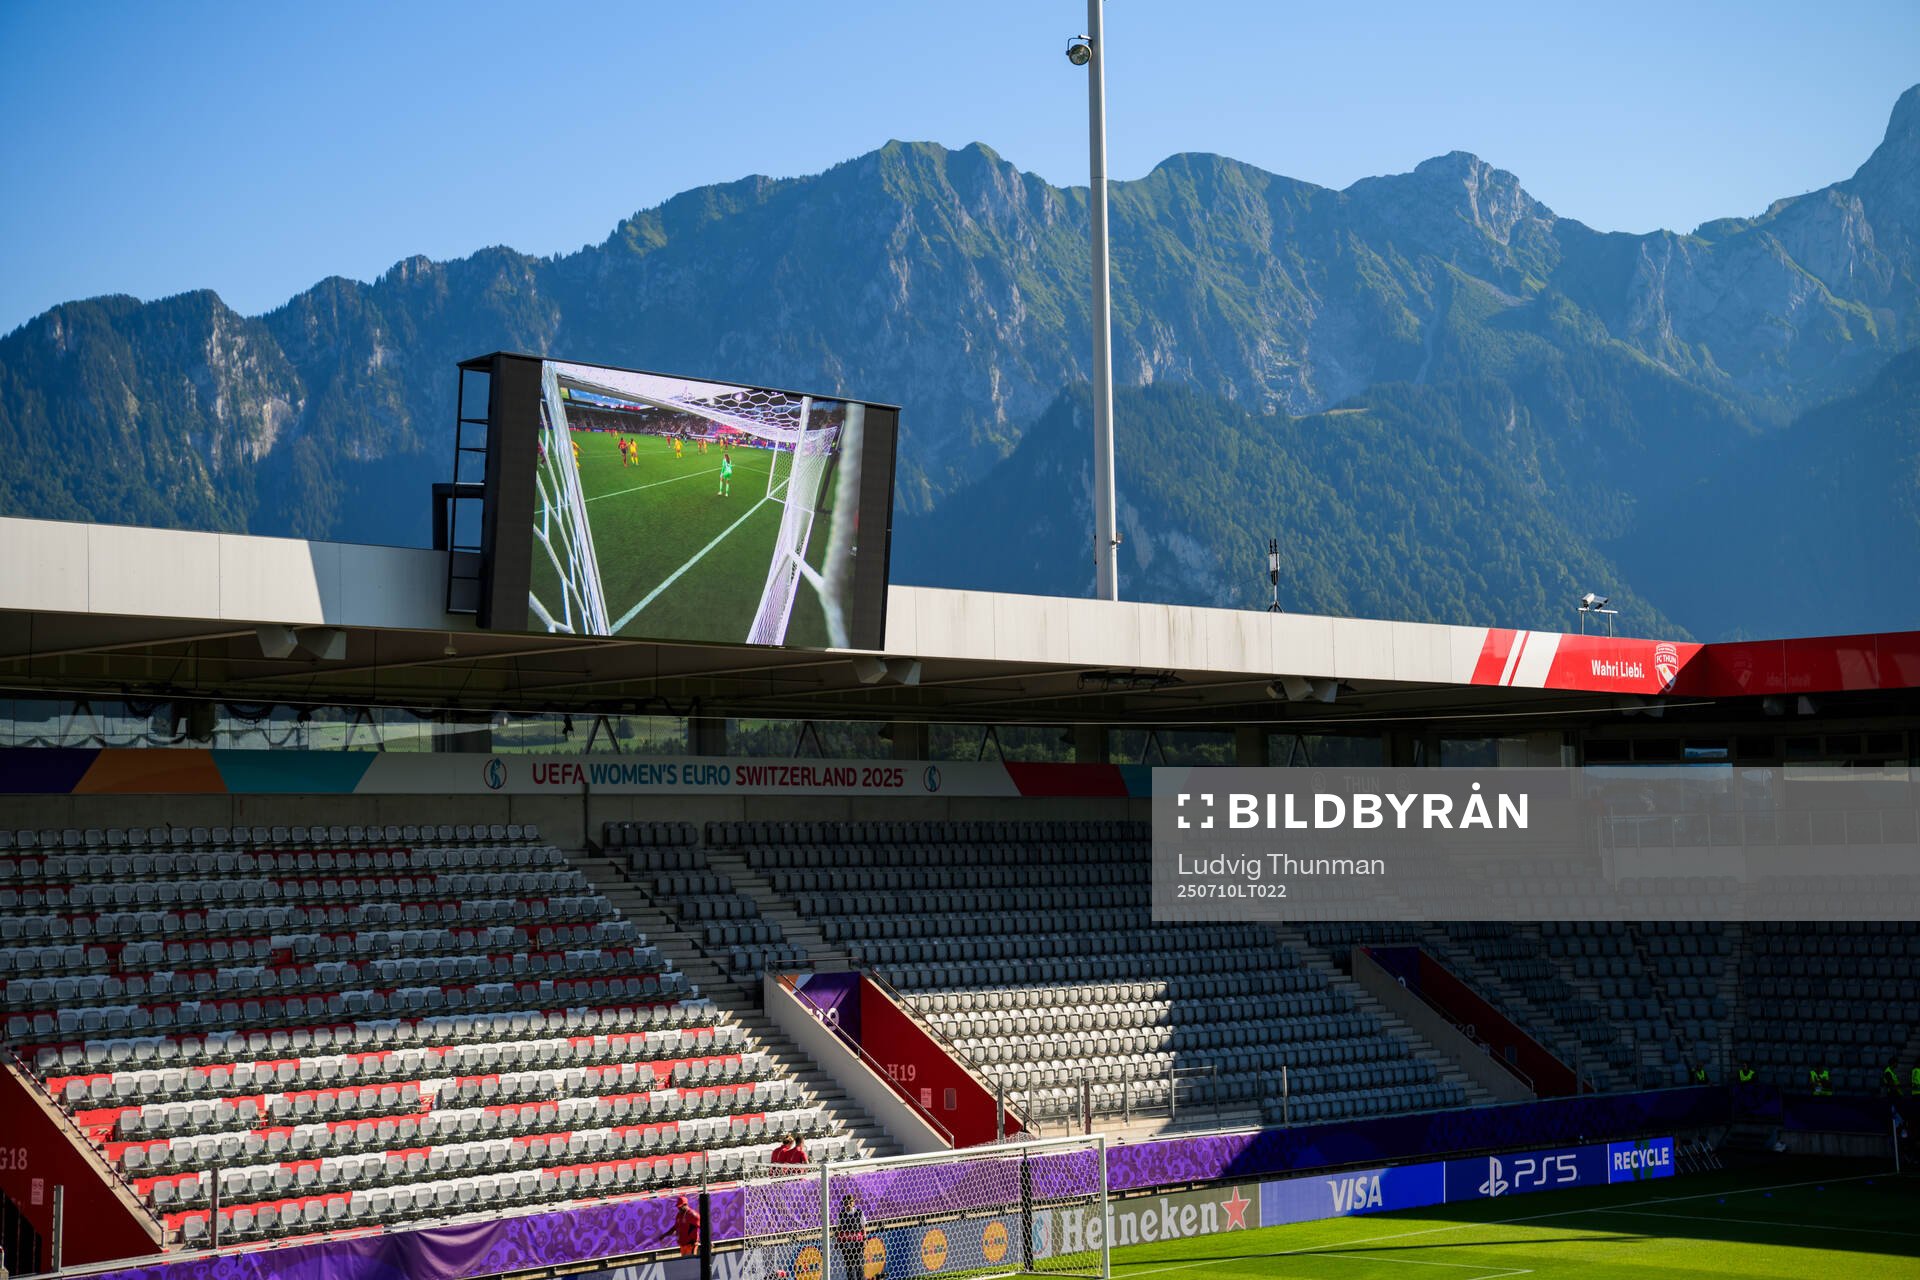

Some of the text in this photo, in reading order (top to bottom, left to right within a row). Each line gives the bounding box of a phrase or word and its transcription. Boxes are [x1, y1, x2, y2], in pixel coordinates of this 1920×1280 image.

[1591, 659, 1645, 679] Wahri Liebi.
[533, 763, 904, 787] UEFA WOMEN'S EURO SWITZERLAND 2025
[1343, 775, 1380, 793] THUN
[887, 1063, 916, 1082] H19
[0, 1146, 28, 1171] G18
[1614, 1147, 1670, 1171] RECYCLE
[1514, 1154, 1578, 1188] PS5
[1326, 1175, 1383, 1212] VISA
[1060, 1198, 1220, 1254] Heineken
